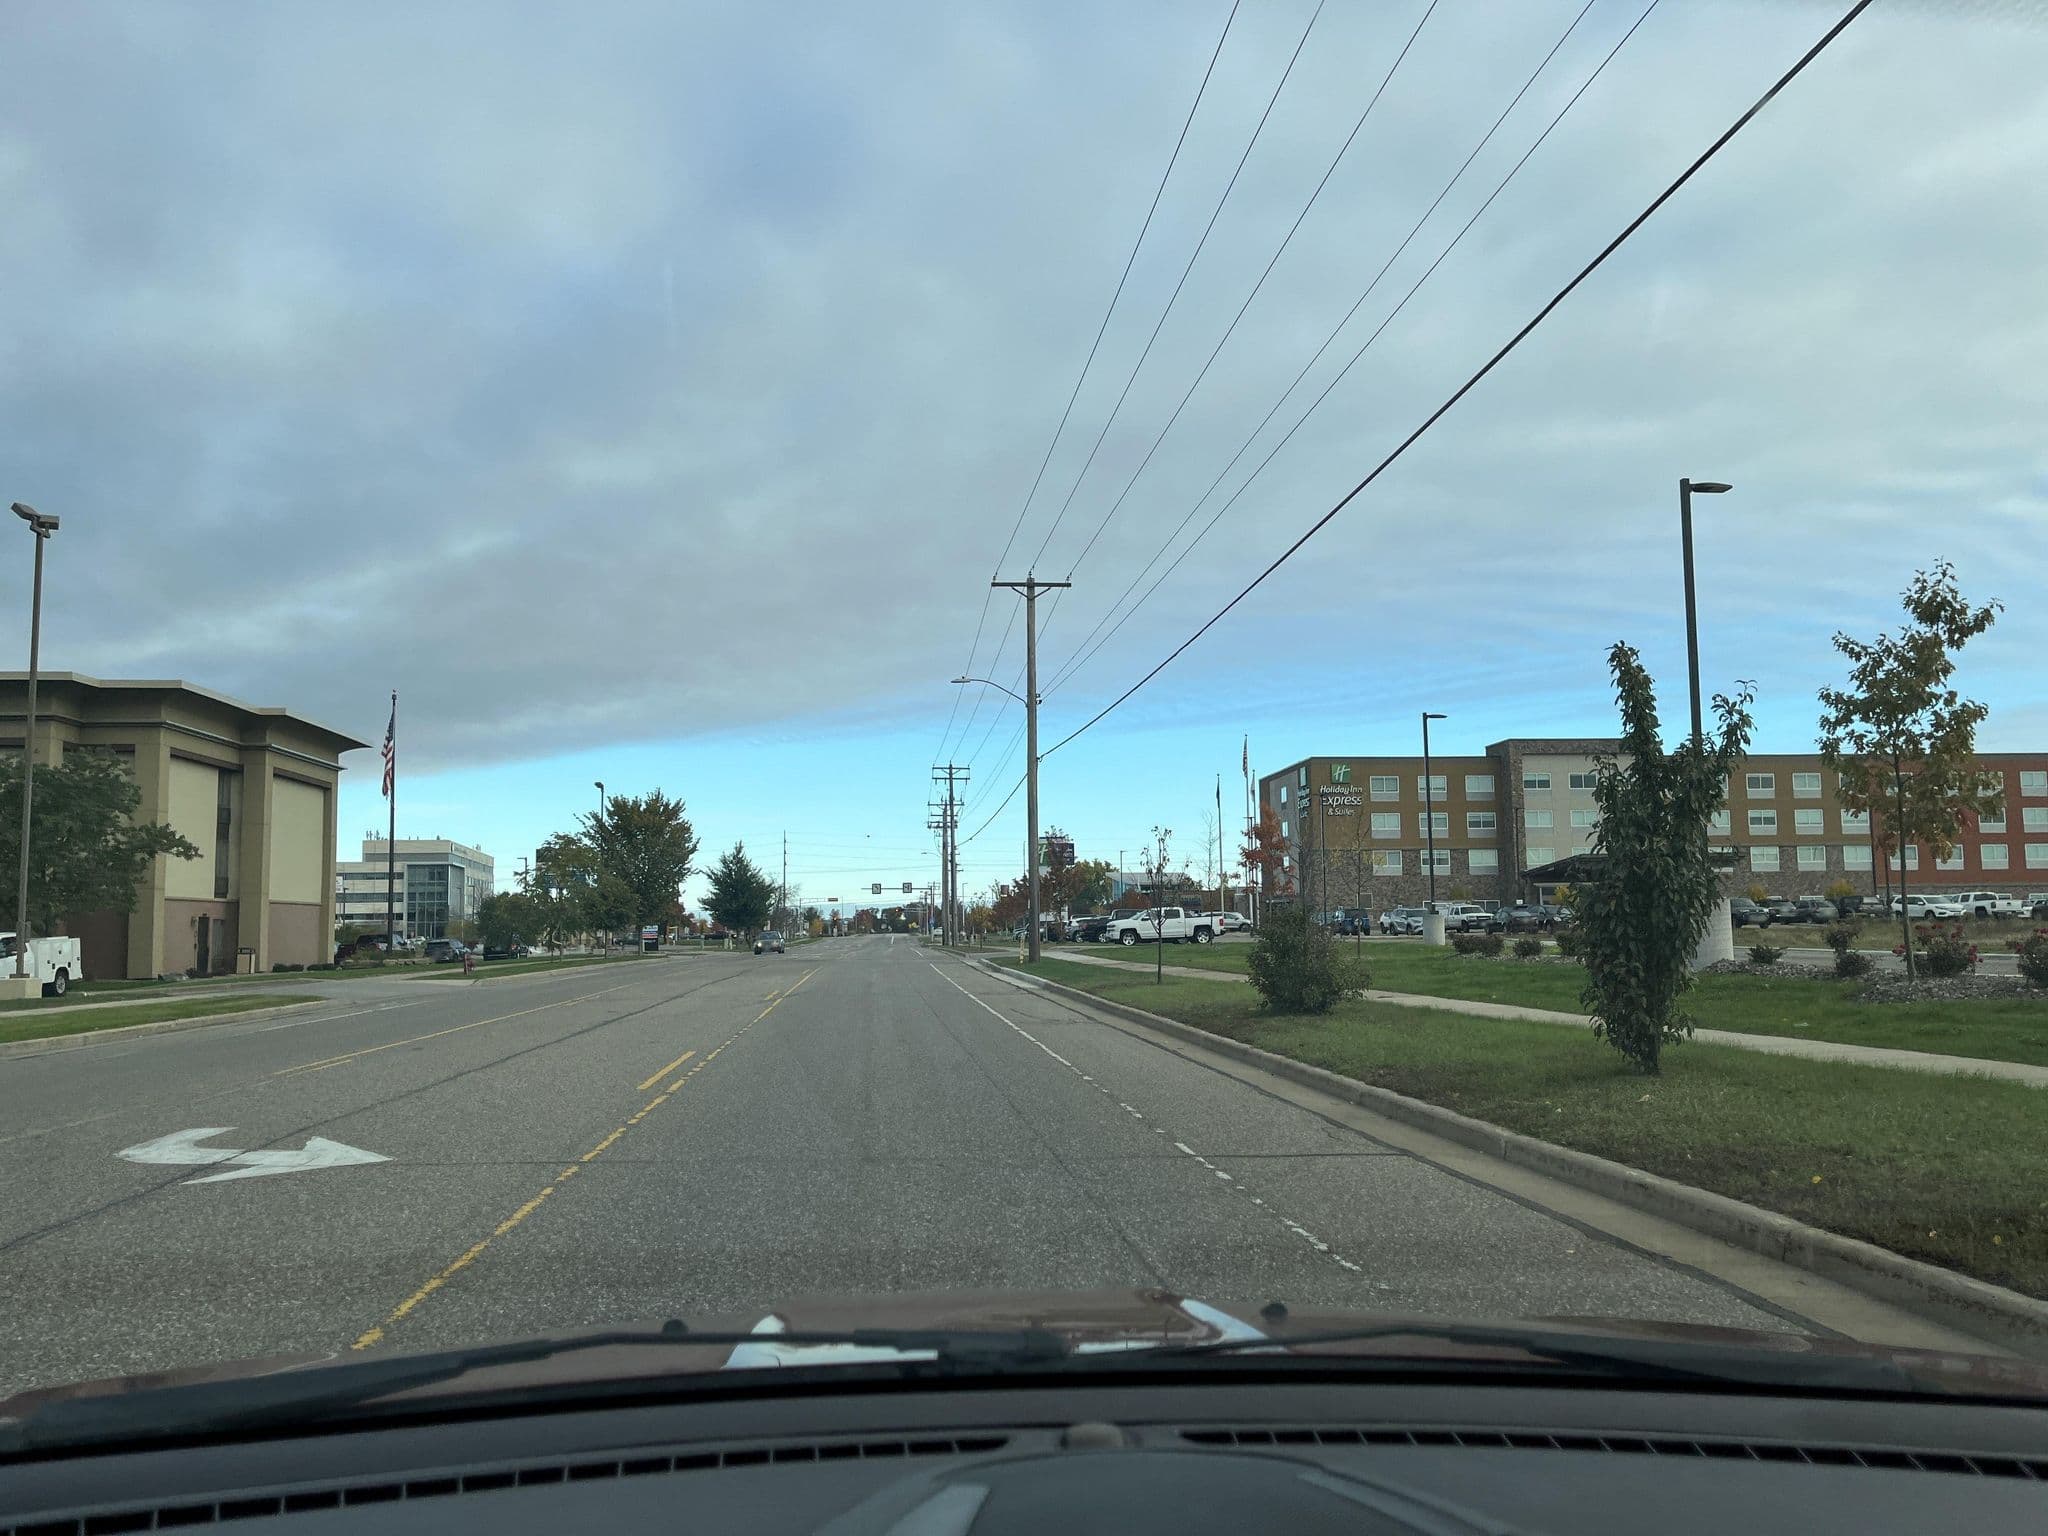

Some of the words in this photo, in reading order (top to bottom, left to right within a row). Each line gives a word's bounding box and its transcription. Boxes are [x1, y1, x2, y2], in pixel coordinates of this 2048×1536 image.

[1320, 785, 1350, 795] Holiday
[1350, 785, 1363, 793] Inn
[1322, 796, 1362, 808] Express
[1327, 808, 1334, 816] &
